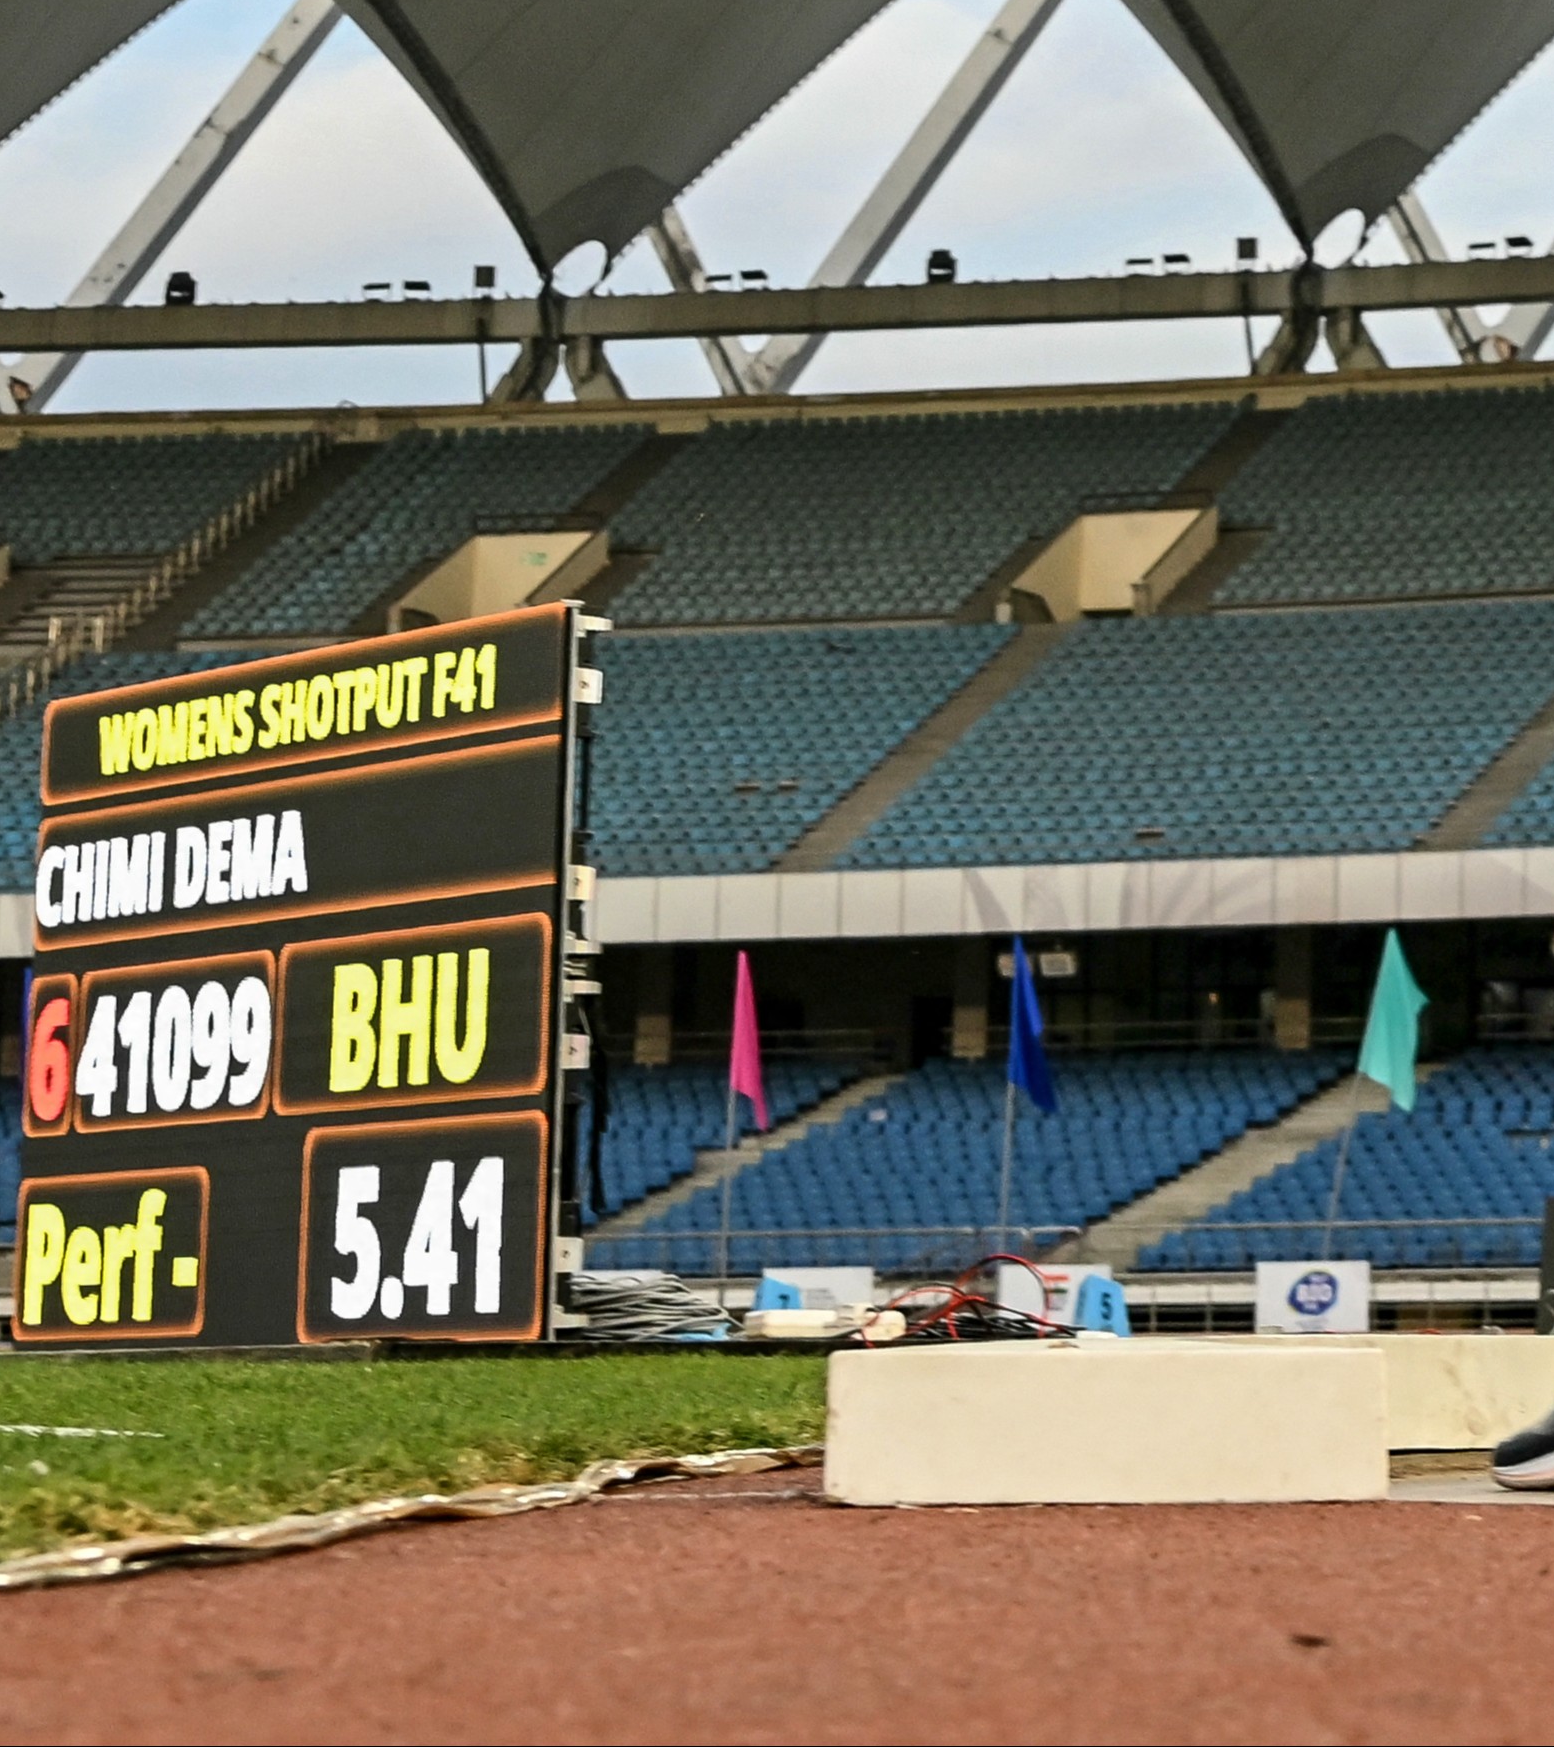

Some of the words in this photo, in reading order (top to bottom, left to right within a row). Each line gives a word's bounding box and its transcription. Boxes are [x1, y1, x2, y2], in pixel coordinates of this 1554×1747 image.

[98, 703, 254, 776] WOMENS
[258, 656, 429, 751] SHOTPUT
[432, 644, 498, 719] F41
[35, 831, 165, 928] CHIMI
[173, 810, 308, 909] DEMA
[31, 996, 71, 1122] 6
[74, 975, 272, 1117] 41099
[328, 948, 491, 1092] BHU
[329, 1156, 505, 1320] 5.41
[1101, 1292, 1113, 1321] 5
